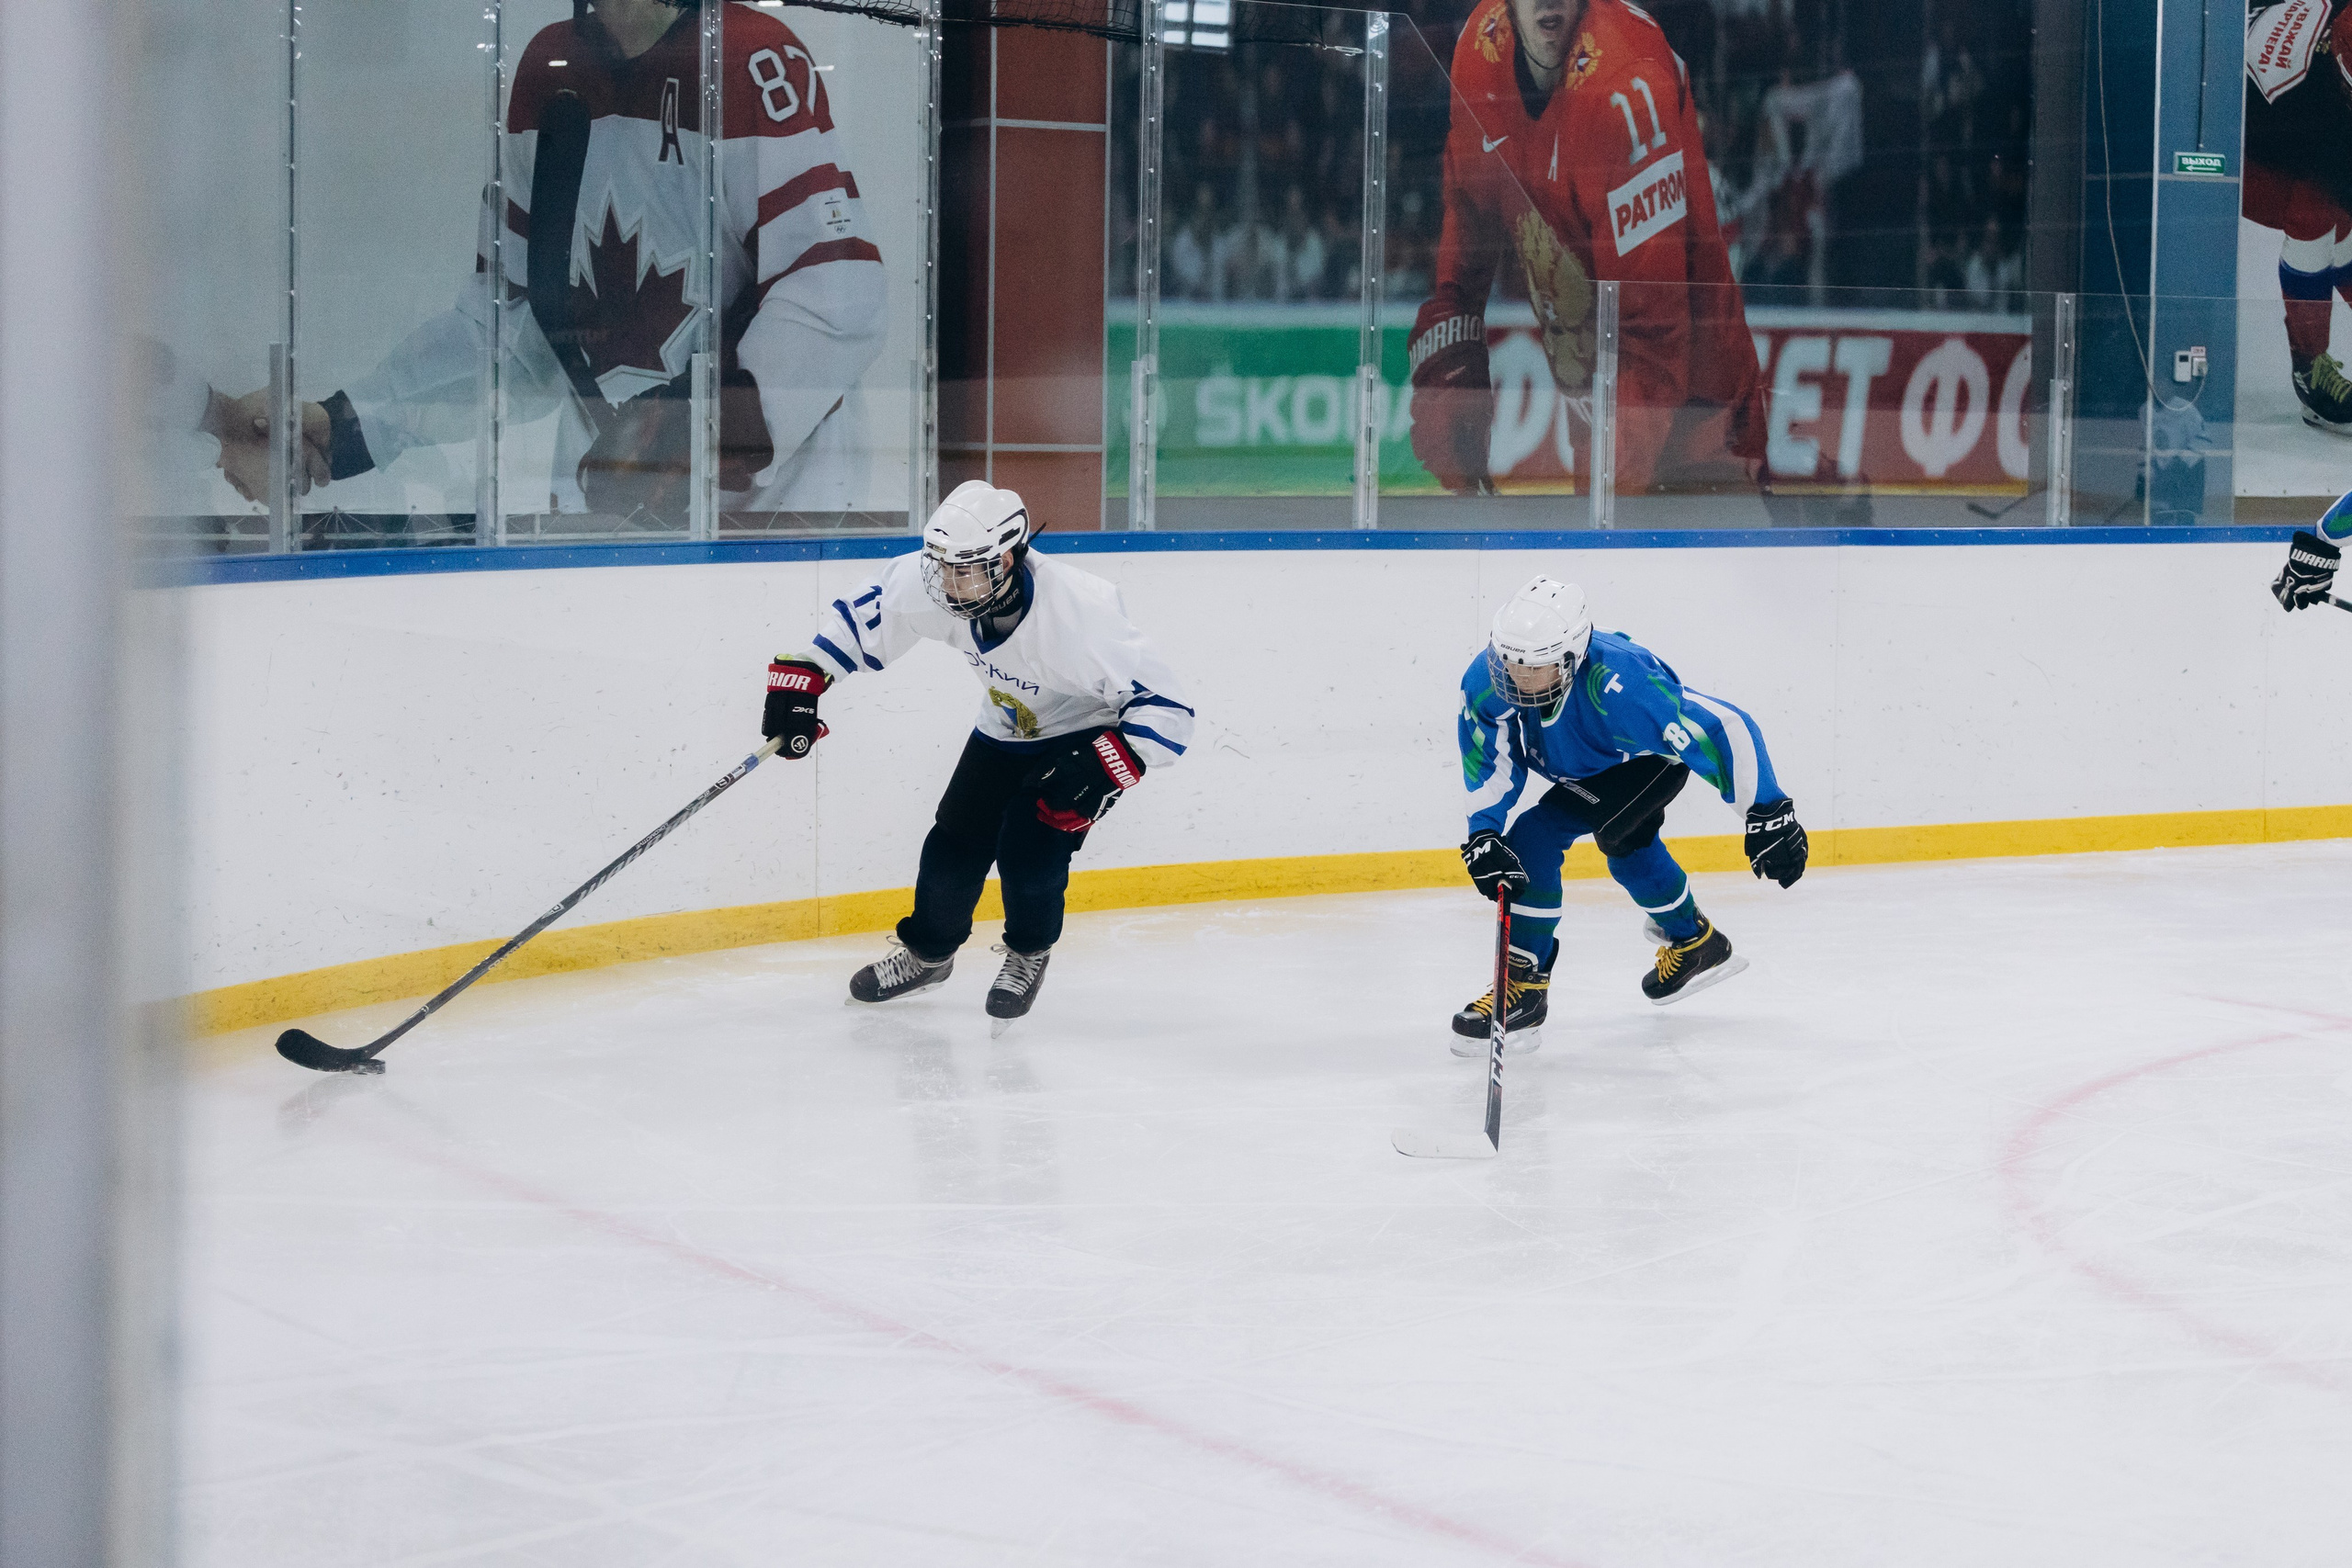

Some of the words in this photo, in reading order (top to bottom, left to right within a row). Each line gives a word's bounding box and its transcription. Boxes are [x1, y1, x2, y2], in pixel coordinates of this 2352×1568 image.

[749, 45, 817, 122] 87
[659, 78, 684, 165] A
[1611, 76, 1667, 165] 11
[2181, 157, 2222, 167] ВЫХОД
[1408, 314, 1486, 374] WARRIO
[989, 588, 1021, 614] AUER
[1500, 643, 1526, 654] BAUER
[768, 671, 811, 691] RIOR
[1747, 811, 1794, 834] CCM
[1490, 1020, 1506, 1088] CCM
